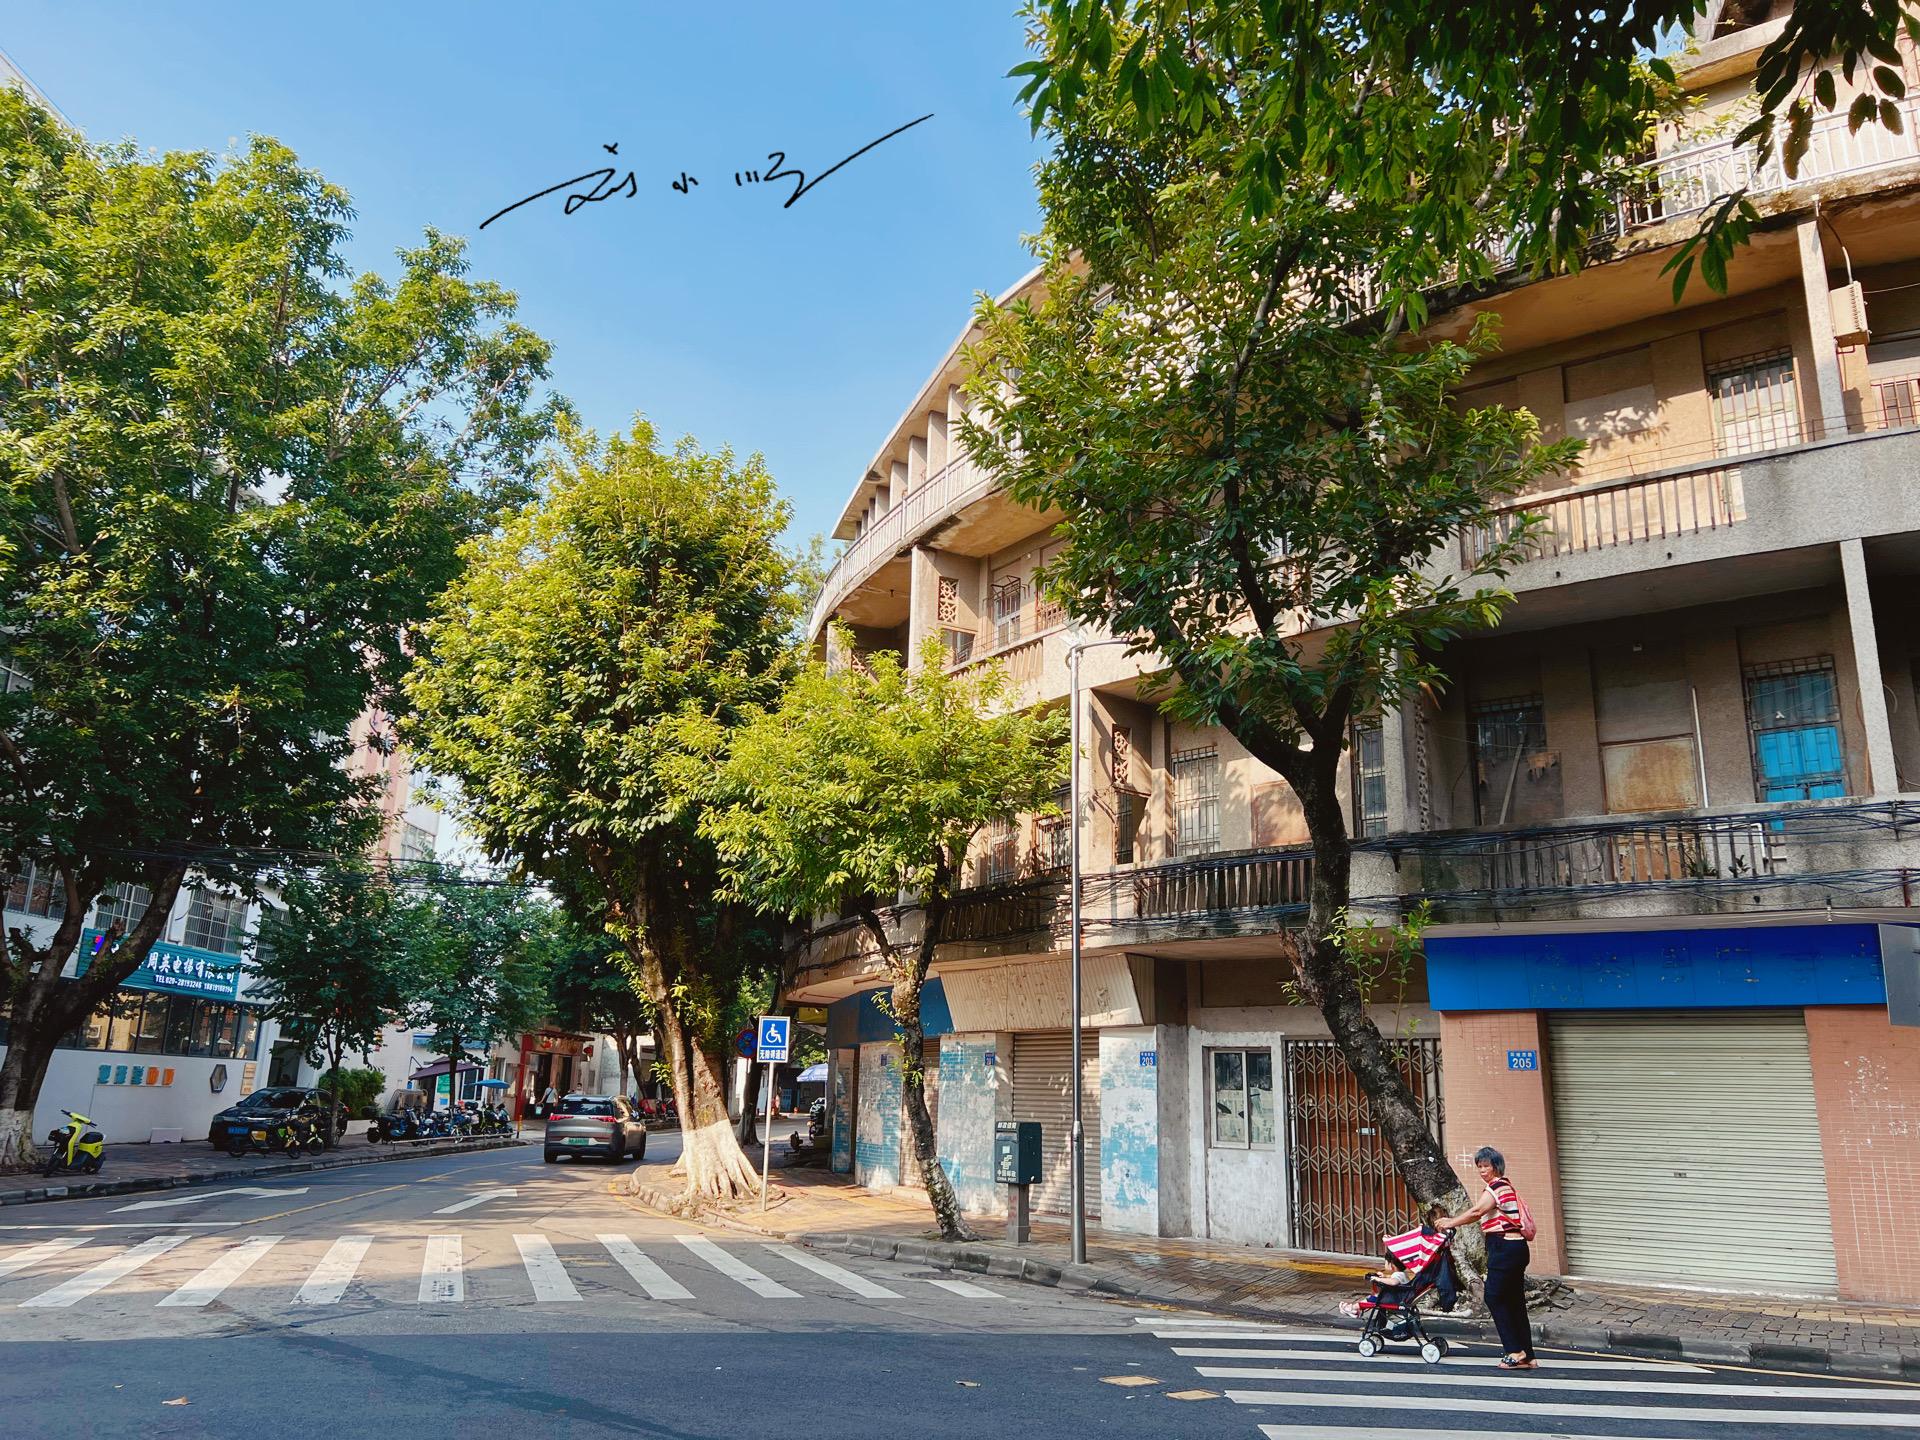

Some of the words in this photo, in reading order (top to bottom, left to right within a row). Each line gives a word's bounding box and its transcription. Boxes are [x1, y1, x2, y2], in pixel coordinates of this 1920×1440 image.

[138, 951, 234, 983] 周英电梯有限公司
[760, 1049, 785, 1059] 无障碍通道
[1141, 1057, 1154, 1066] 203
[1512, 1057, 1532, 1068] 205
[997, 1169, 1017, 1178] 中国邮政
